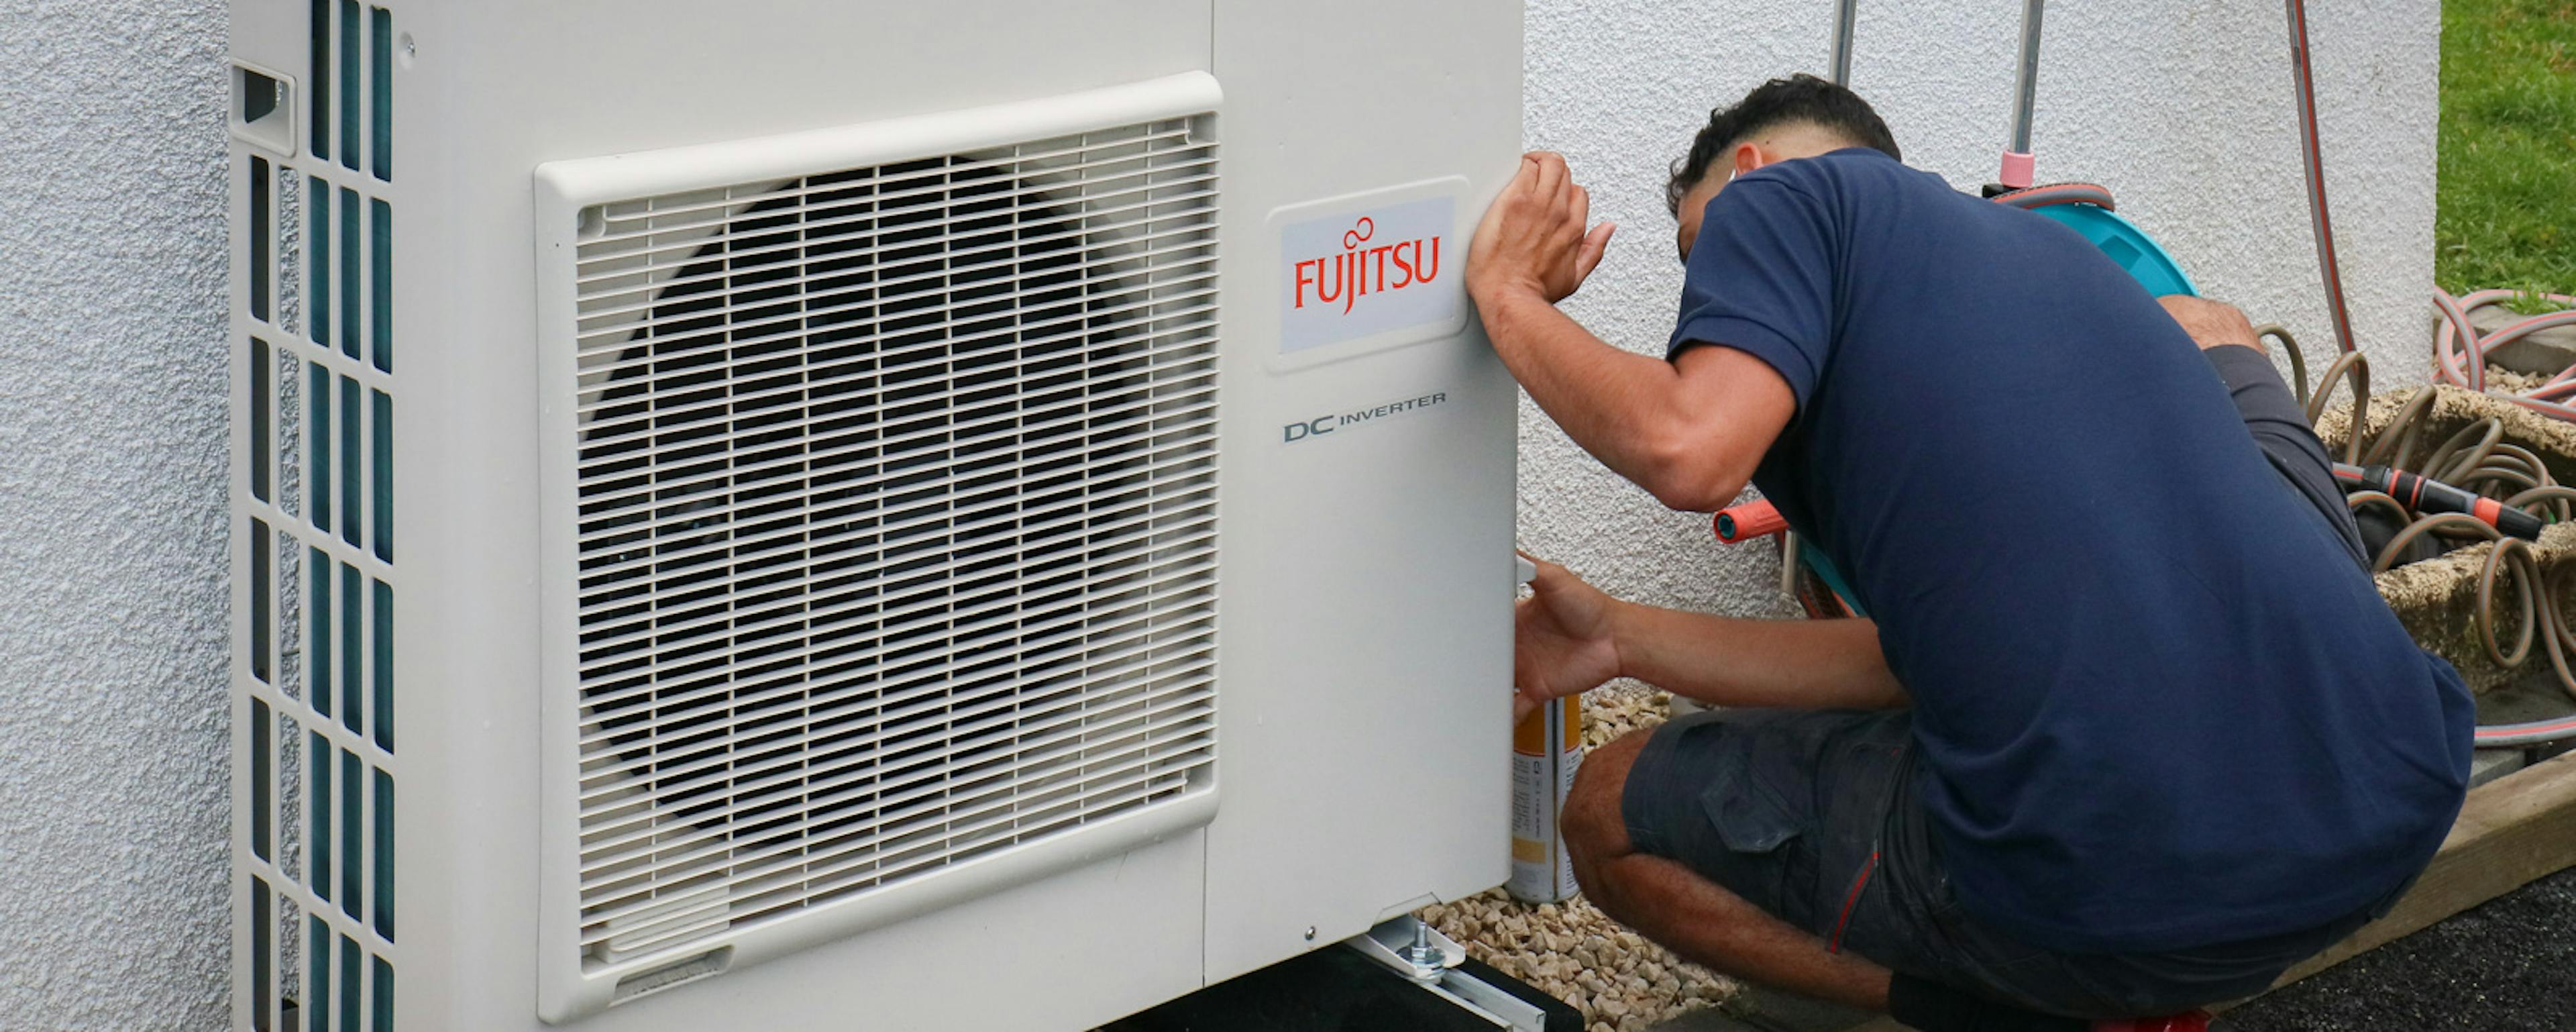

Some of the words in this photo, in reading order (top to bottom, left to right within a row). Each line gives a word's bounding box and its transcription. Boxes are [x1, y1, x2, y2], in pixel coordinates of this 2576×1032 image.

[1294, 236, 1440, 315] FUJITSU
[1284, 415, 1334, 443] DC
[1340, 393, 1446, 425] INVERTER
